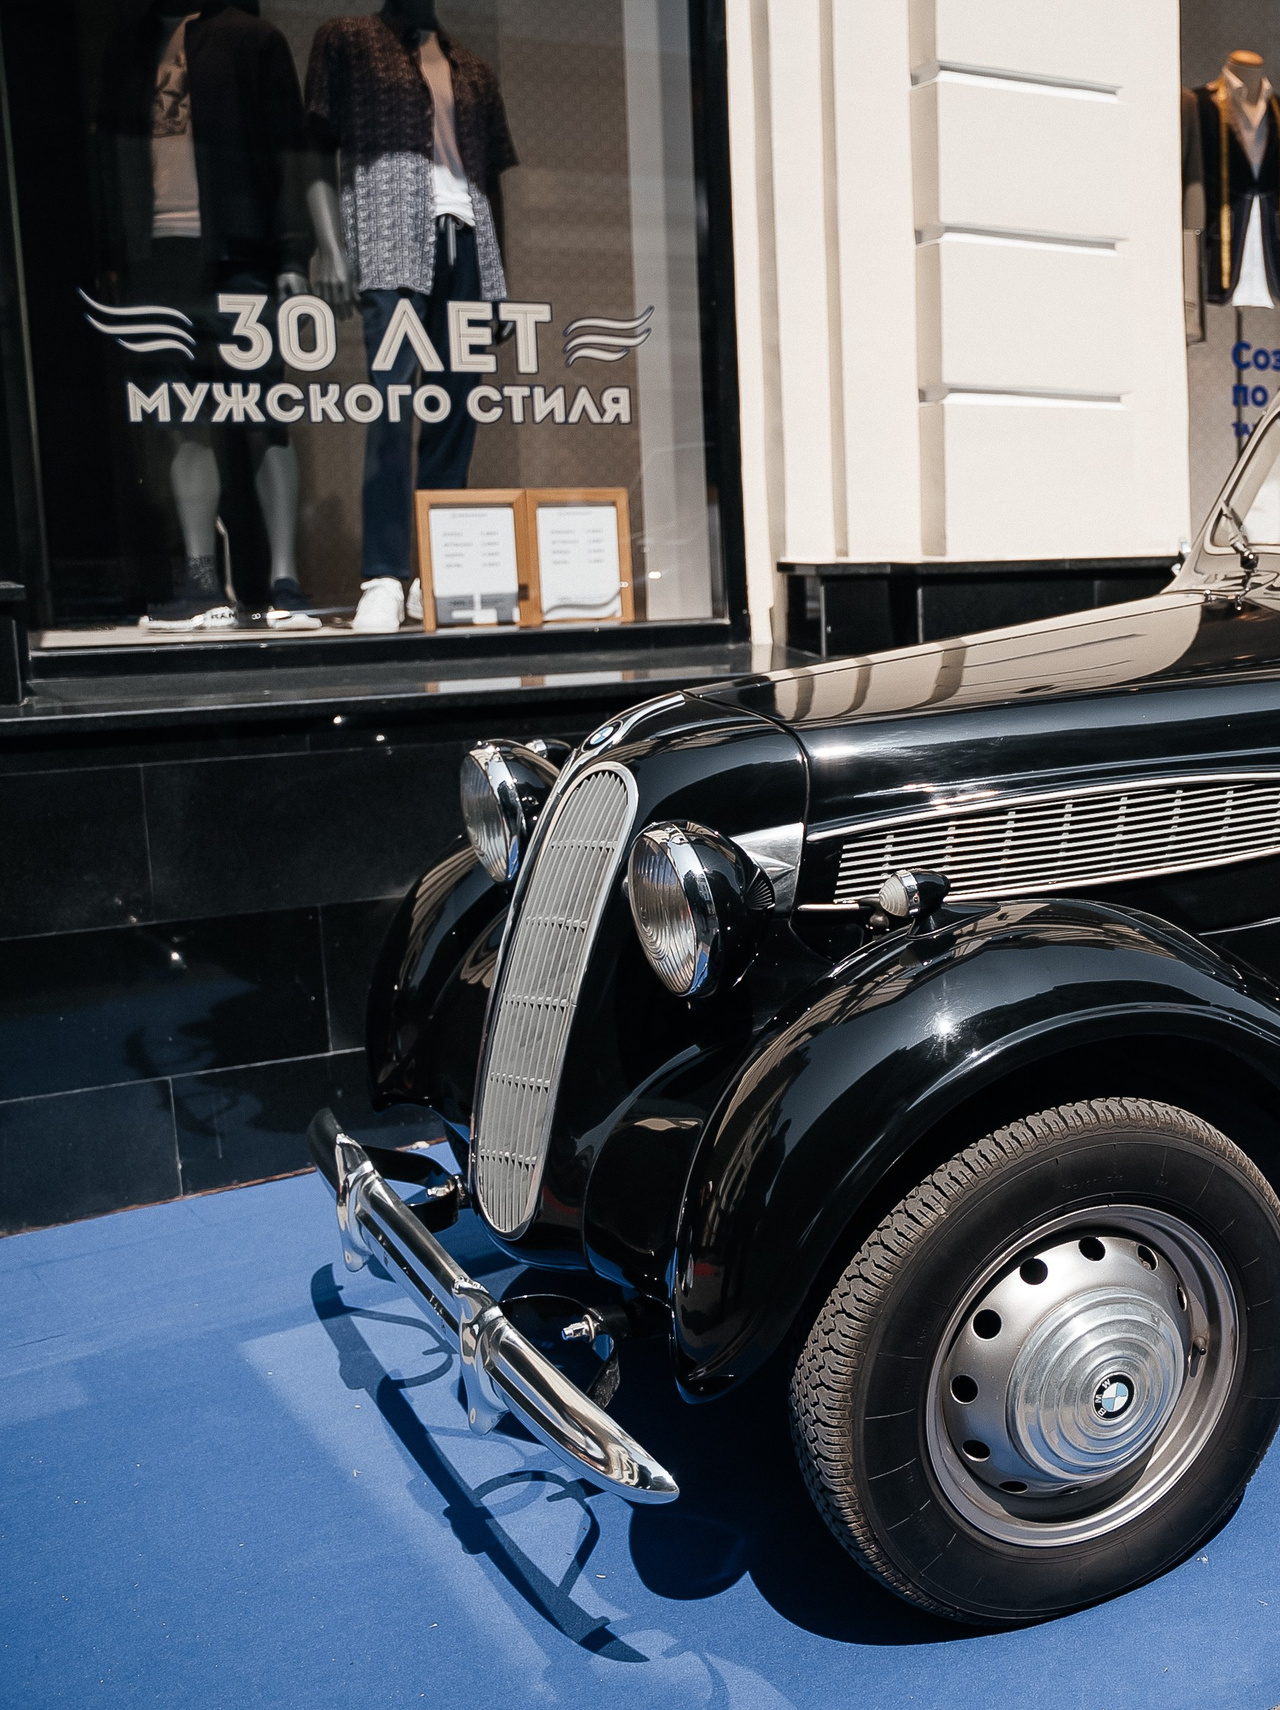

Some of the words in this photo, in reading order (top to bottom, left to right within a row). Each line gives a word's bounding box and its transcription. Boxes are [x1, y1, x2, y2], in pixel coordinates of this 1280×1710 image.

[217, 293, 338, 372] 30
[371, 297, 552, 374] ЛЕТ
[126, 382, 452, 424] МУЖСКОГО
[466, 385, 632, 424] СТИЛЯ
[1232, 384, 1268, 408] по
[1094, 1378, 1111, 1417] BMW
